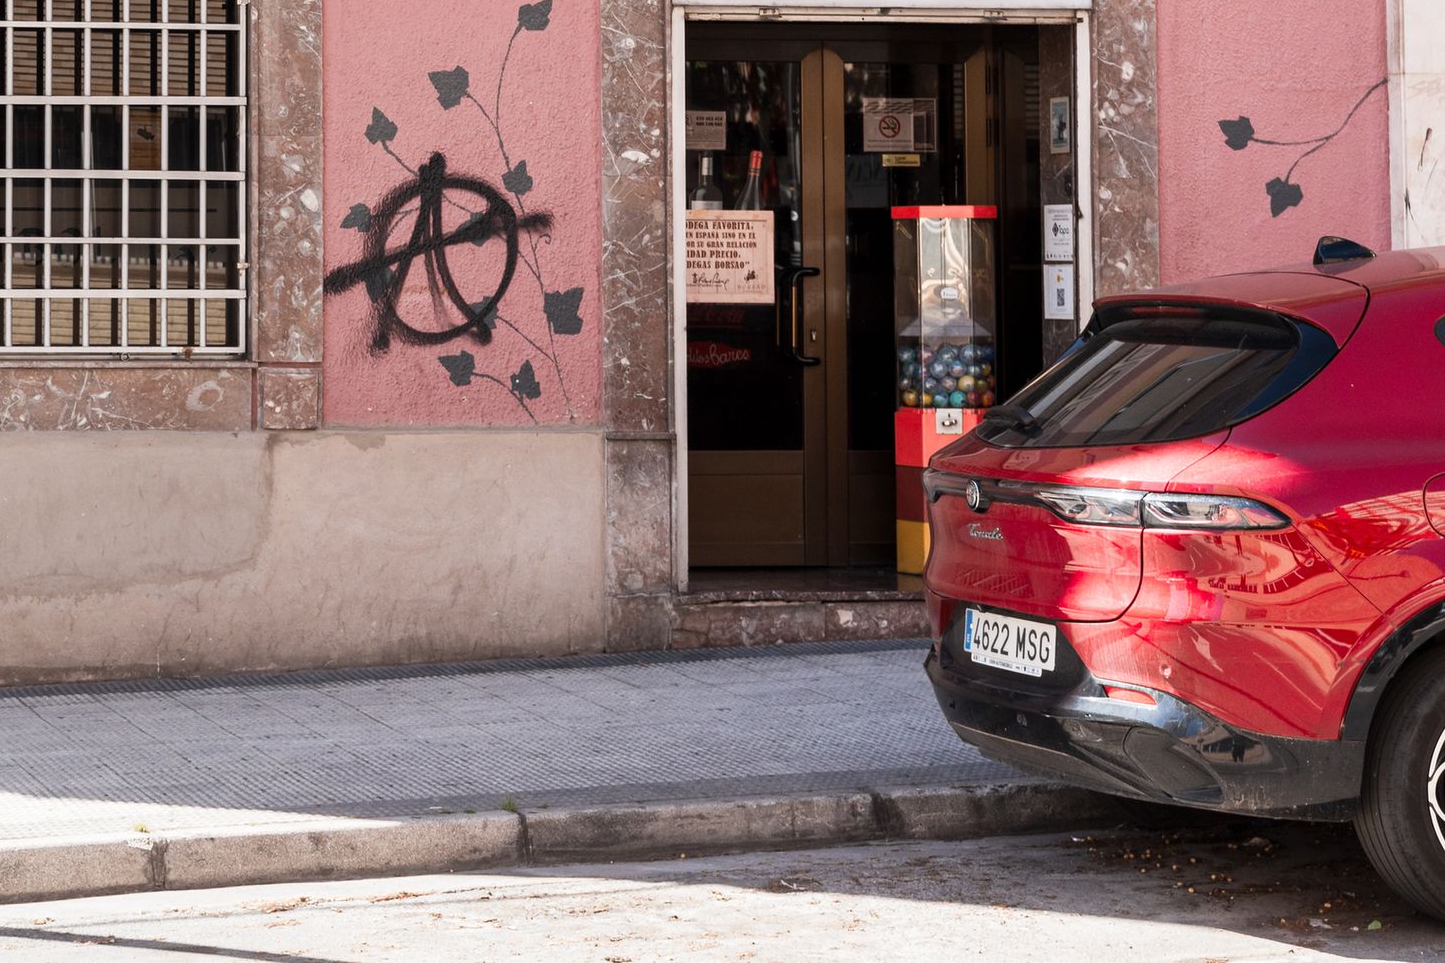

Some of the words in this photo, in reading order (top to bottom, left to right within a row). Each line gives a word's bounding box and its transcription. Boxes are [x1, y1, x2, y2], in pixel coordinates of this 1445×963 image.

[712, 221, 754, 230] FAVORITA.
[695, 231, 719, 239] ESPAÑA
[726, 240, 757, 249] RELACIÓN
[710, 250, 741, 258] PRECIO.
[973, 618, 1010, 656] 4622
[1015, 625, 1050, 664] MSG
